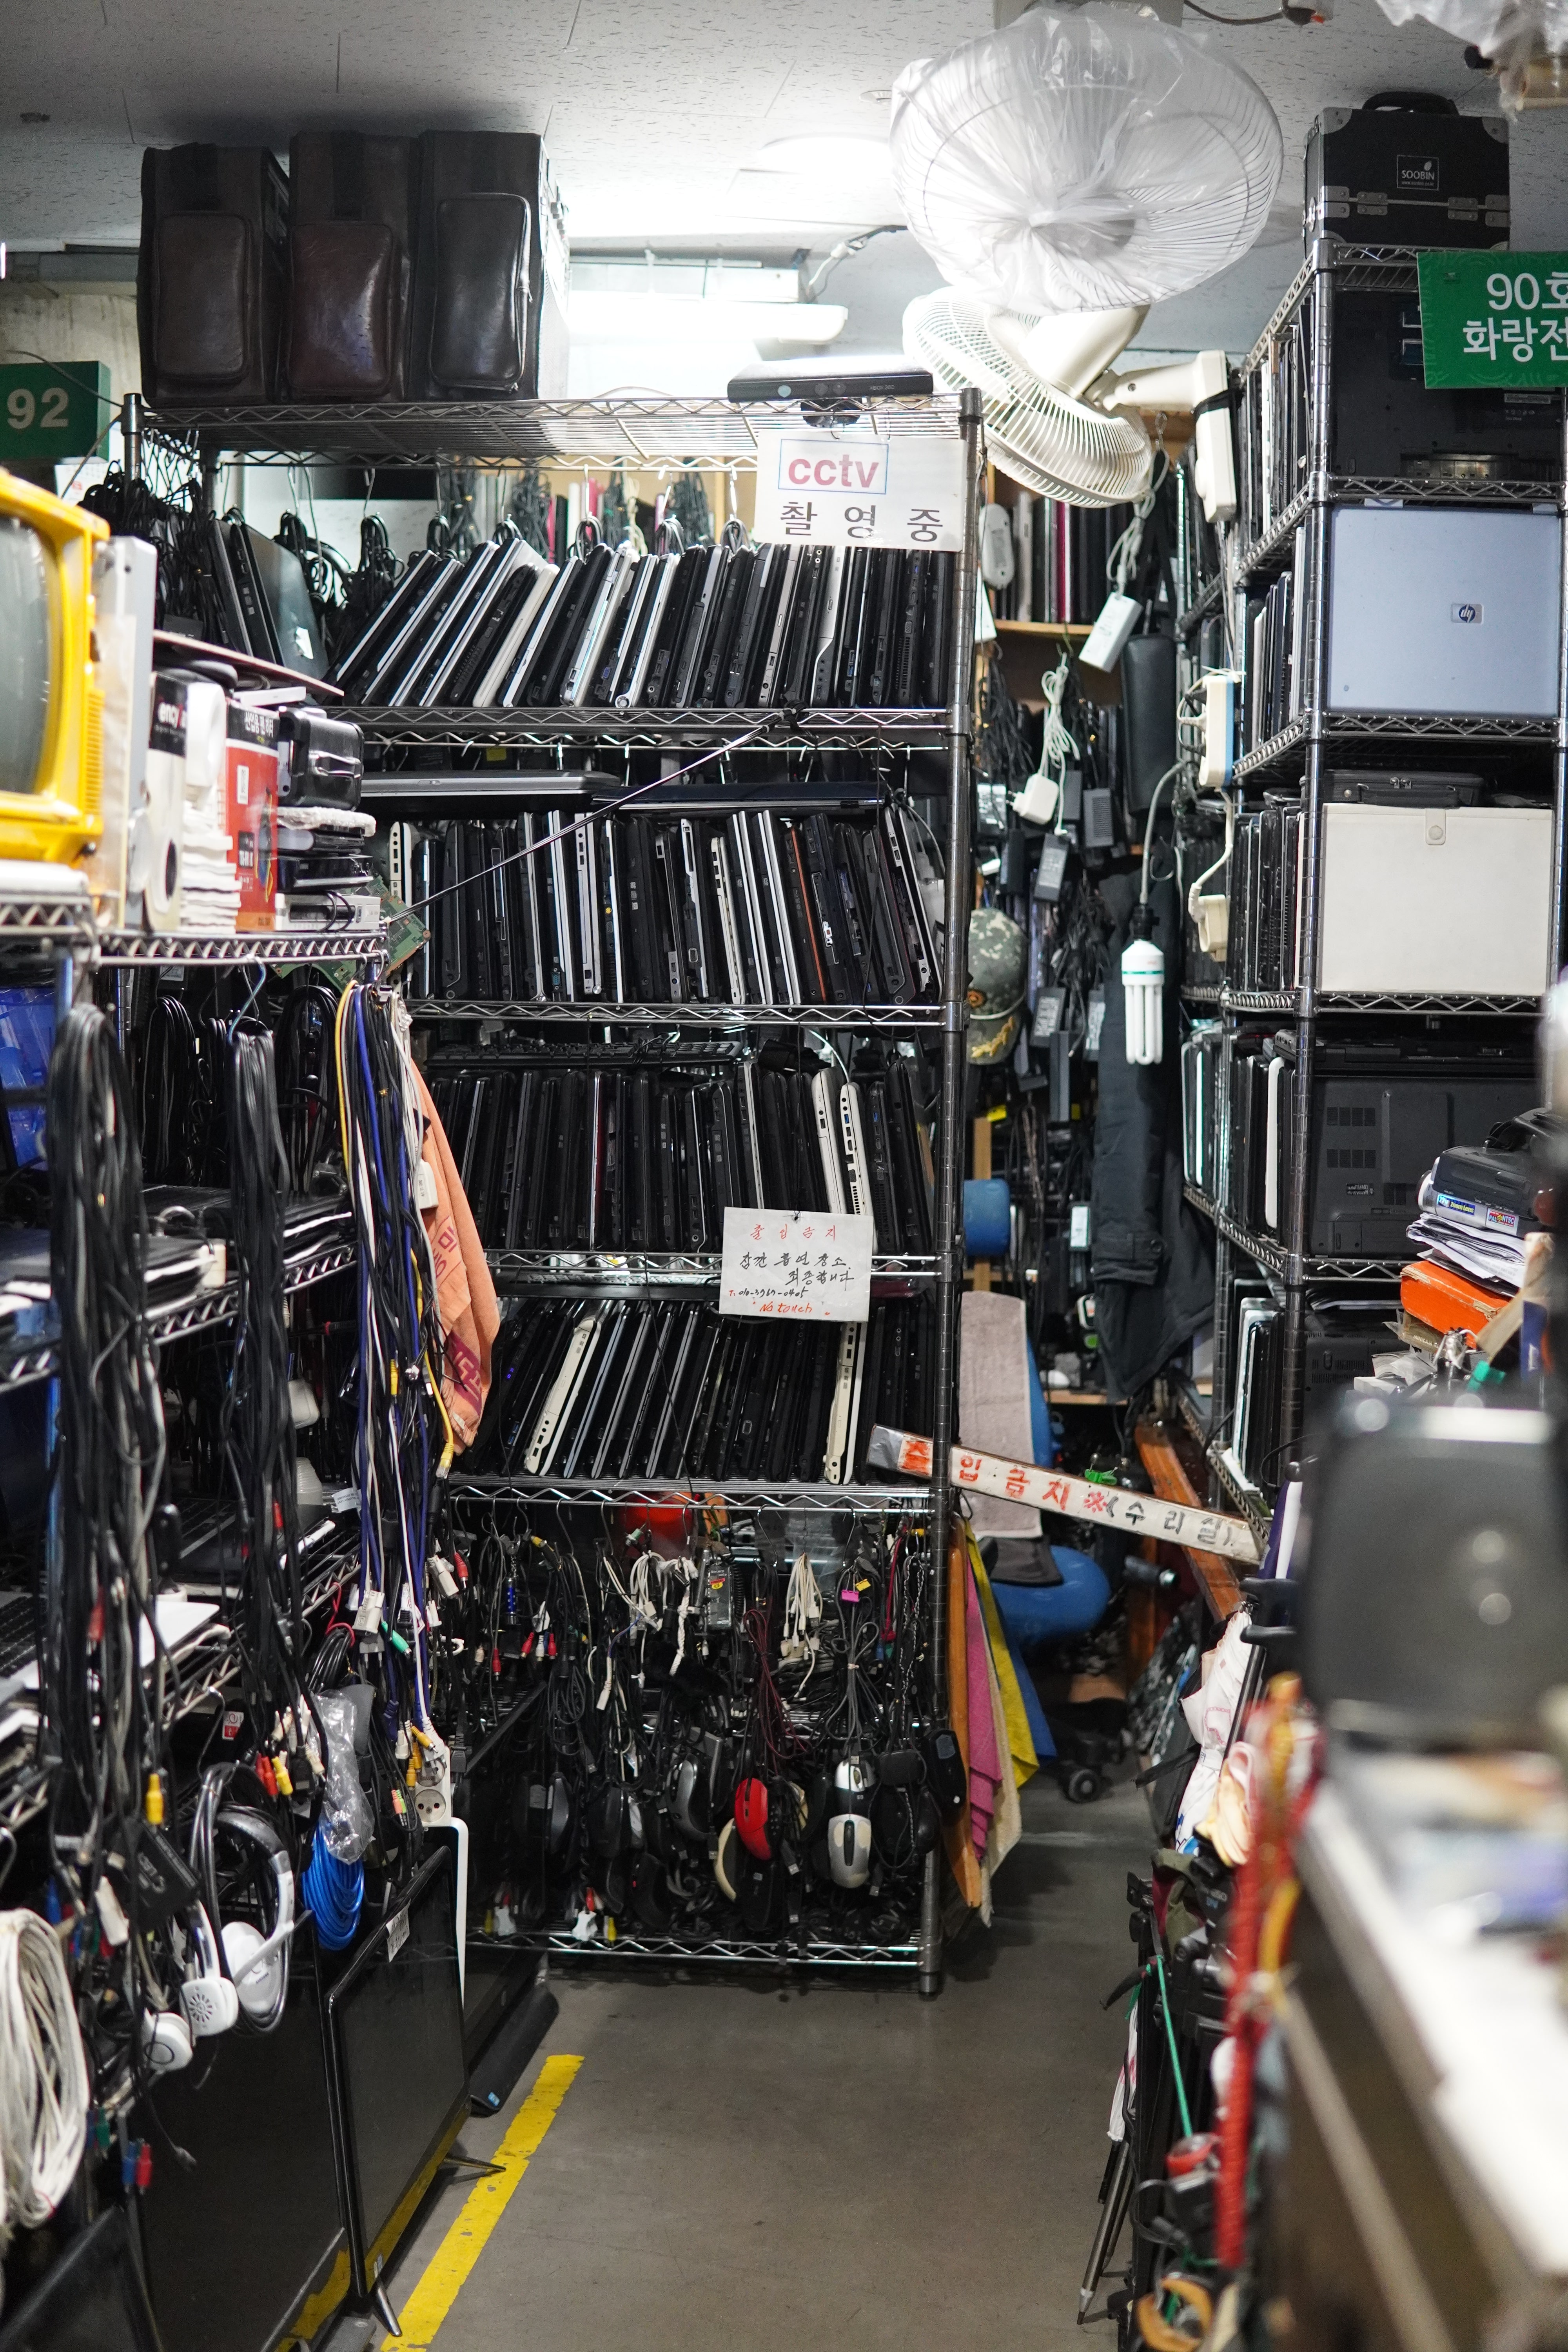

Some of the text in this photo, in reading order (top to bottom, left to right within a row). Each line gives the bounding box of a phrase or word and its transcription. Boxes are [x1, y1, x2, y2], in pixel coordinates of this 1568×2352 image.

[1401, 170, 1435, 180] SOOBIN
[7, 387, 69, 429] 92
[788, 454, 879, 488] cctv
[1450, 1202, 1463, 1210] Zoom
[1502, 1215, 1515, 1225] NTSC
[777, 1303, 813, 1313] touch
